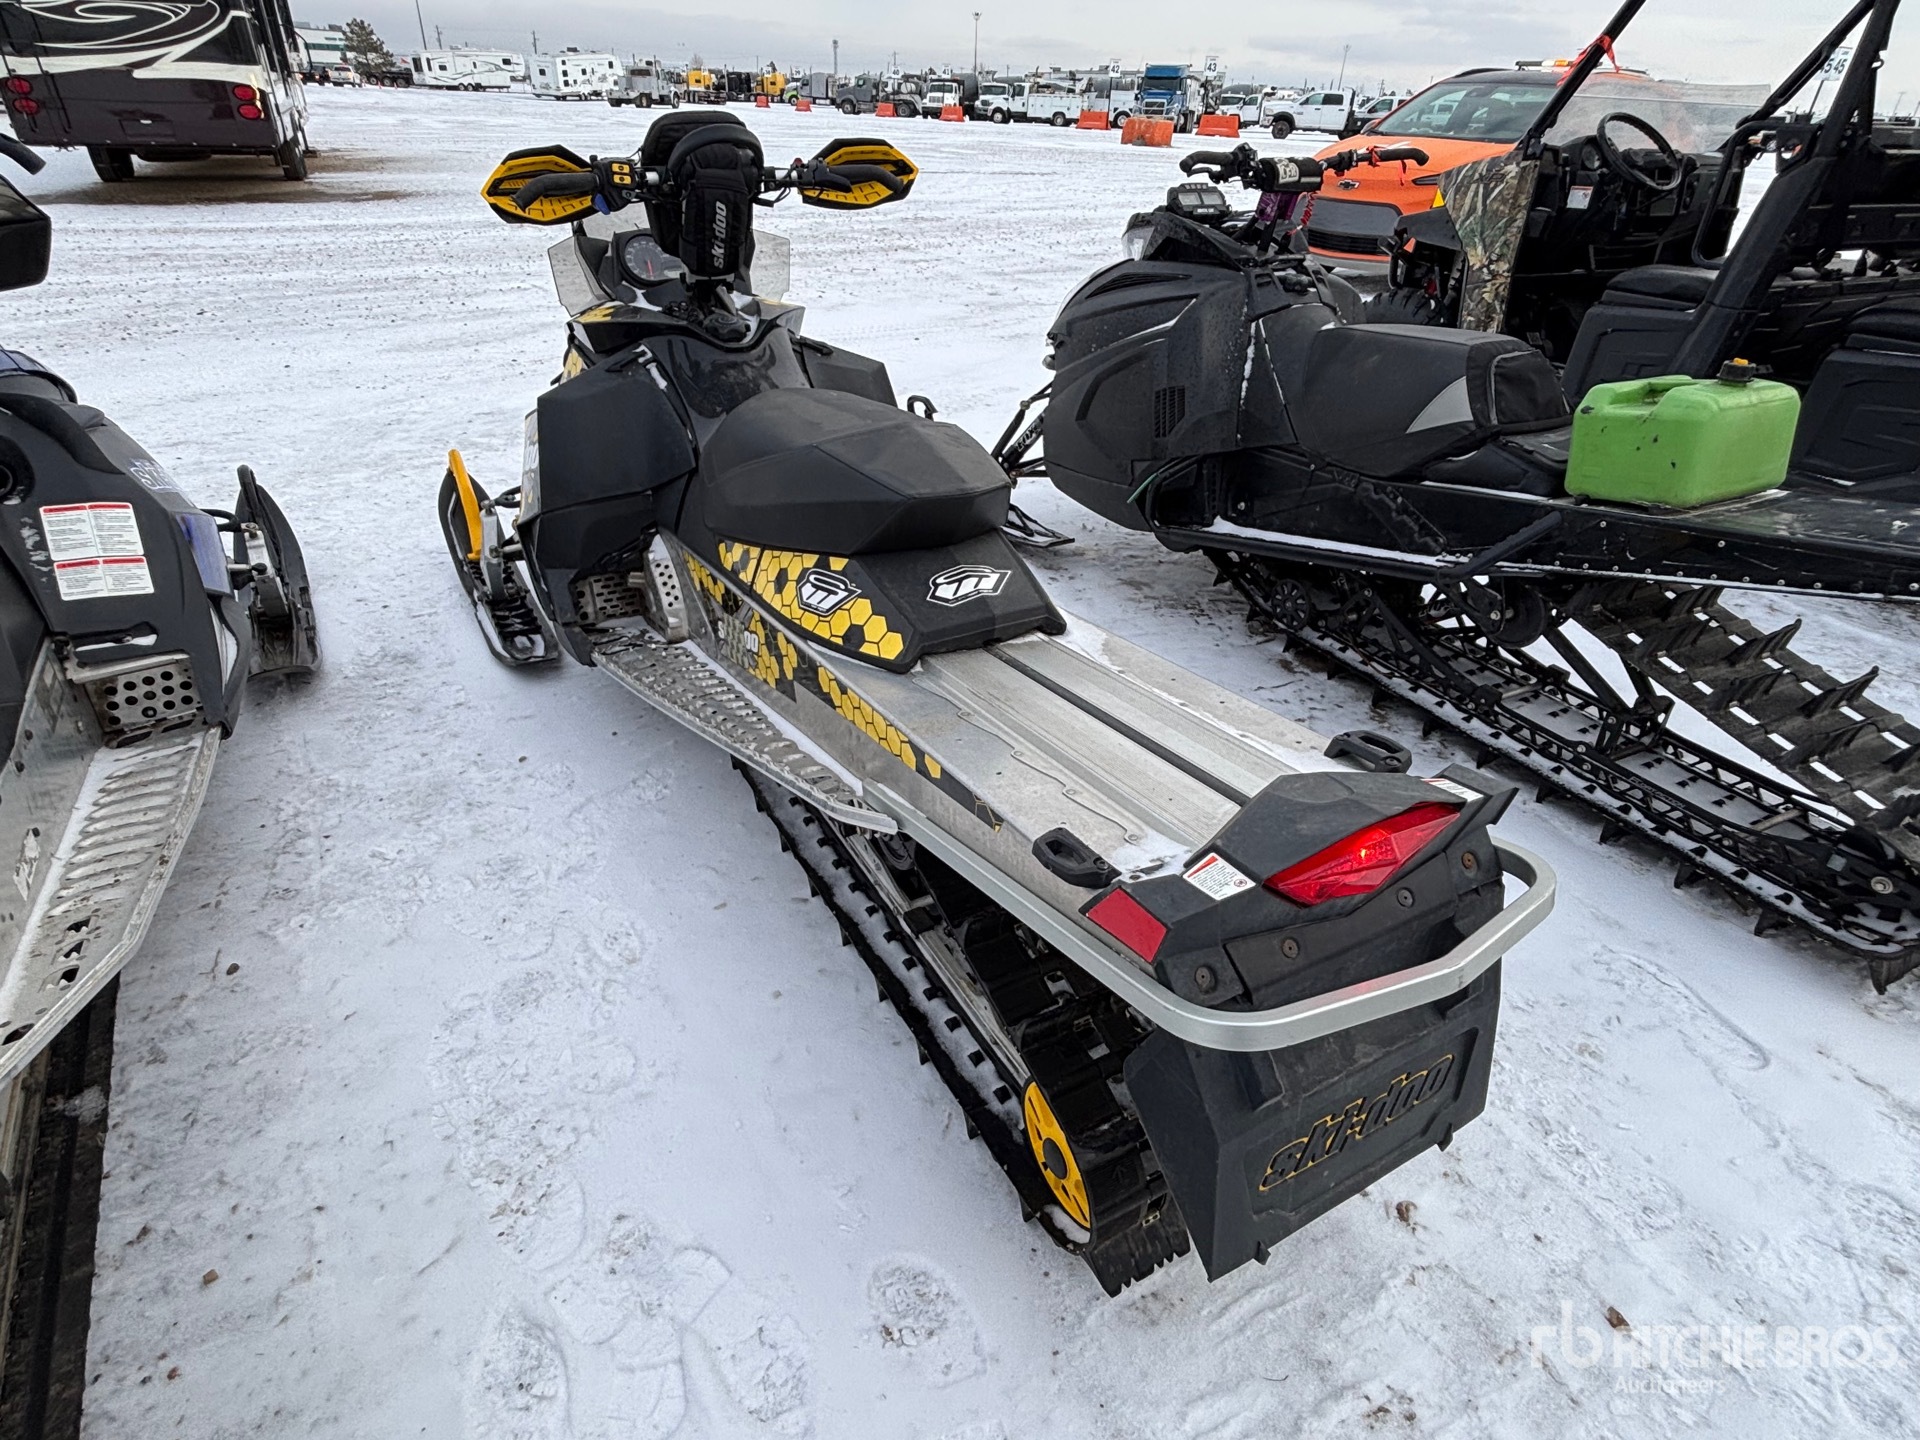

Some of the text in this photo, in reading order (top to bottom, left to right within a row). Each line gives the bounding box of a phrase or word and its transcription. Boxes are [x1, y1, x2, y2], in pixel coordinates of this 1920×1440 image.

[1110, 64, 1121, 74] 42
[1206, 62, 1218, 73] 43
[1833, 58, 1848, 75] 45
[711, 200, 727, 269] ski-doo
[1258, 1053, 1455, 1192] ski-doo
